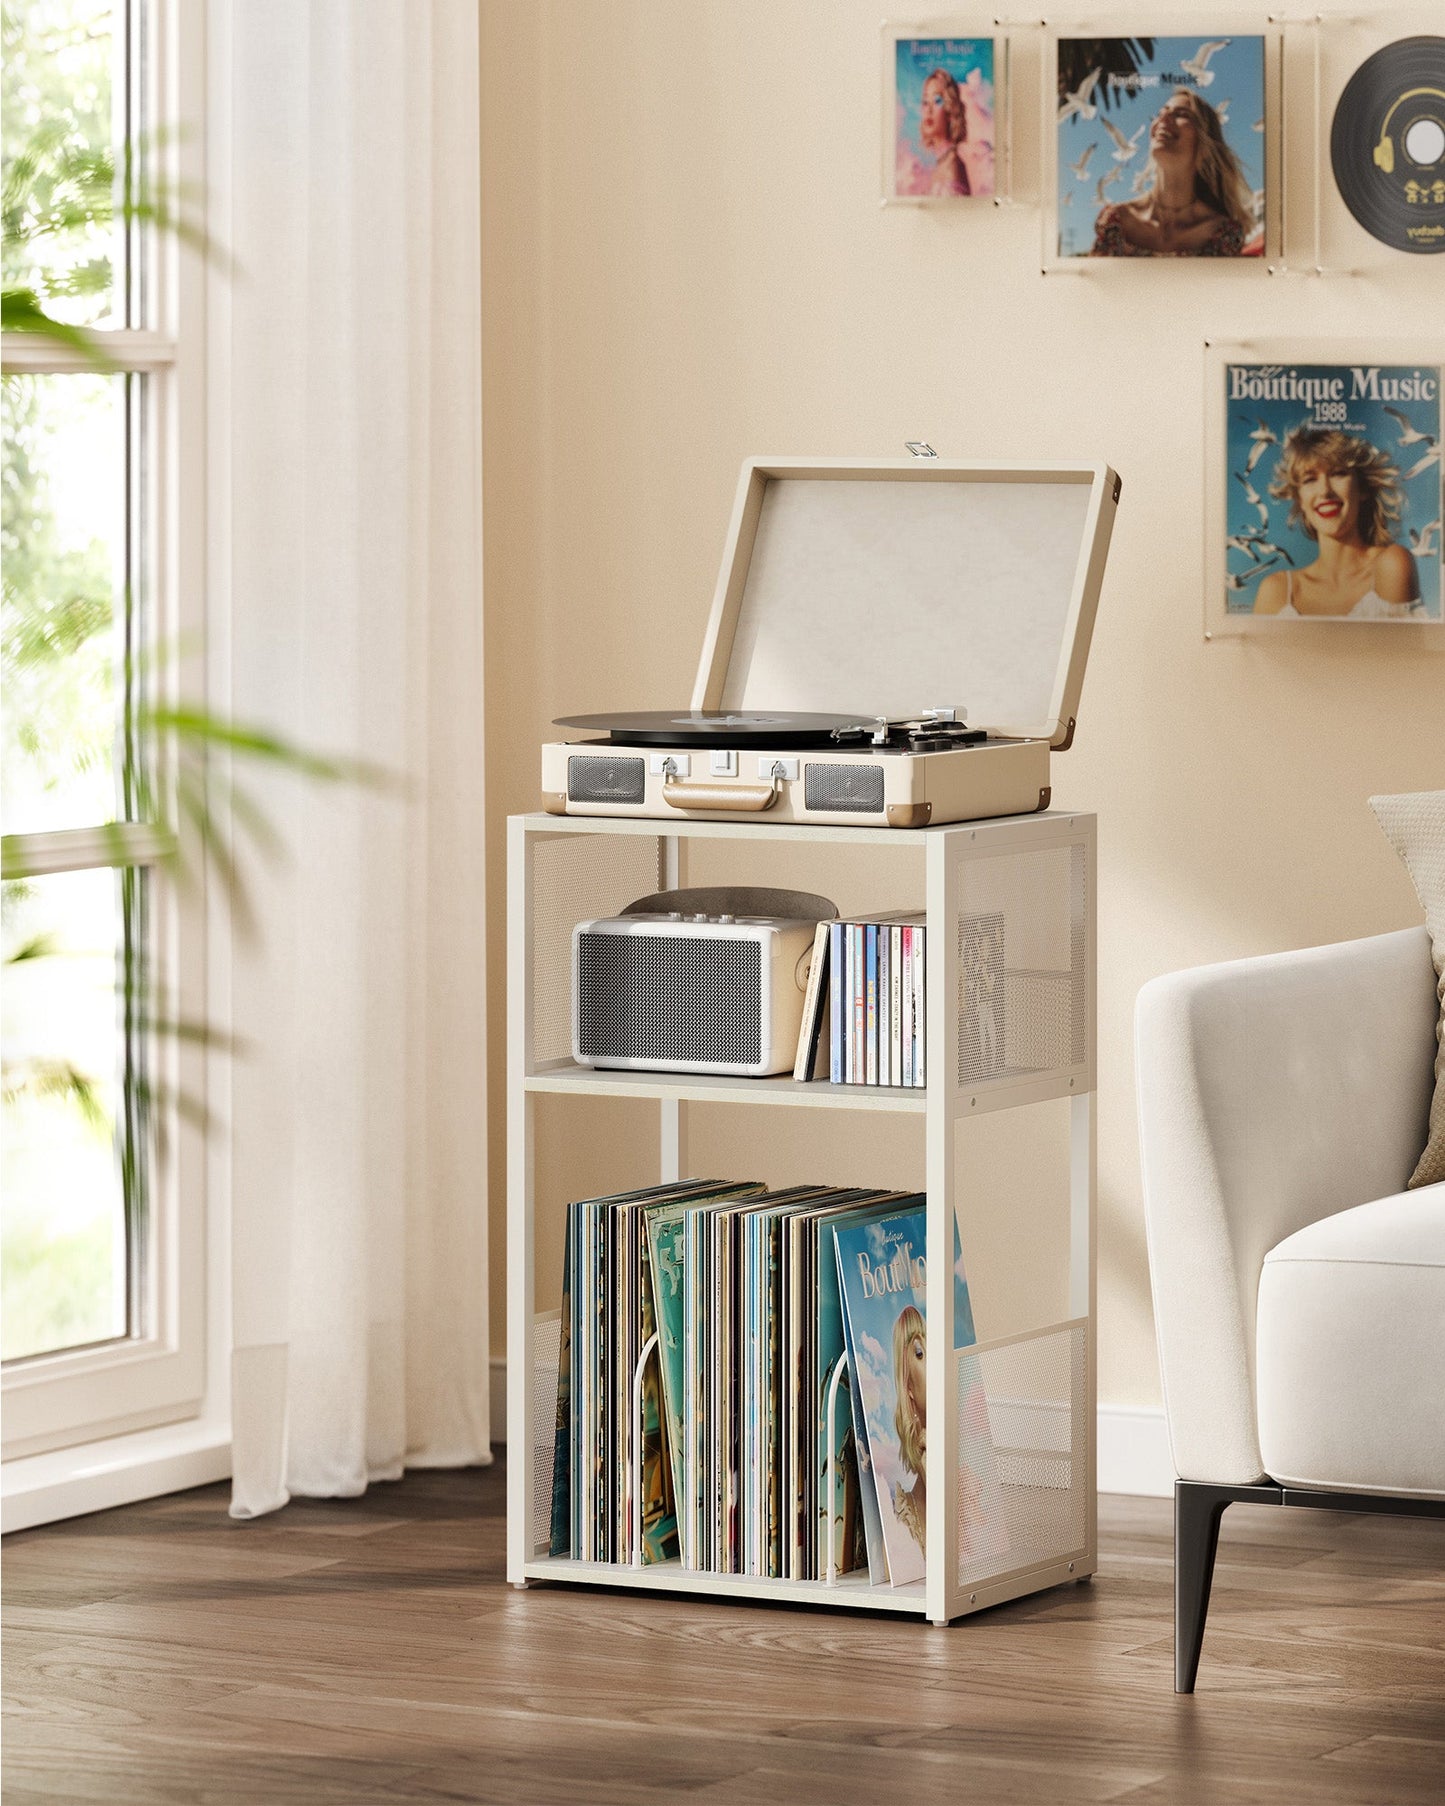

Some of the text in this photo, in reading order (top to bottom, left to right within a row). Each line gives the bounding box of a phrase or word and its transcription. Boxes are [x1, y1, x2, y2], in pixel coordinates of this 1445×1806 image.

[1230, 367, 1436, 408] Boutique Music
[1314, 402, 1347, 421] 1988
